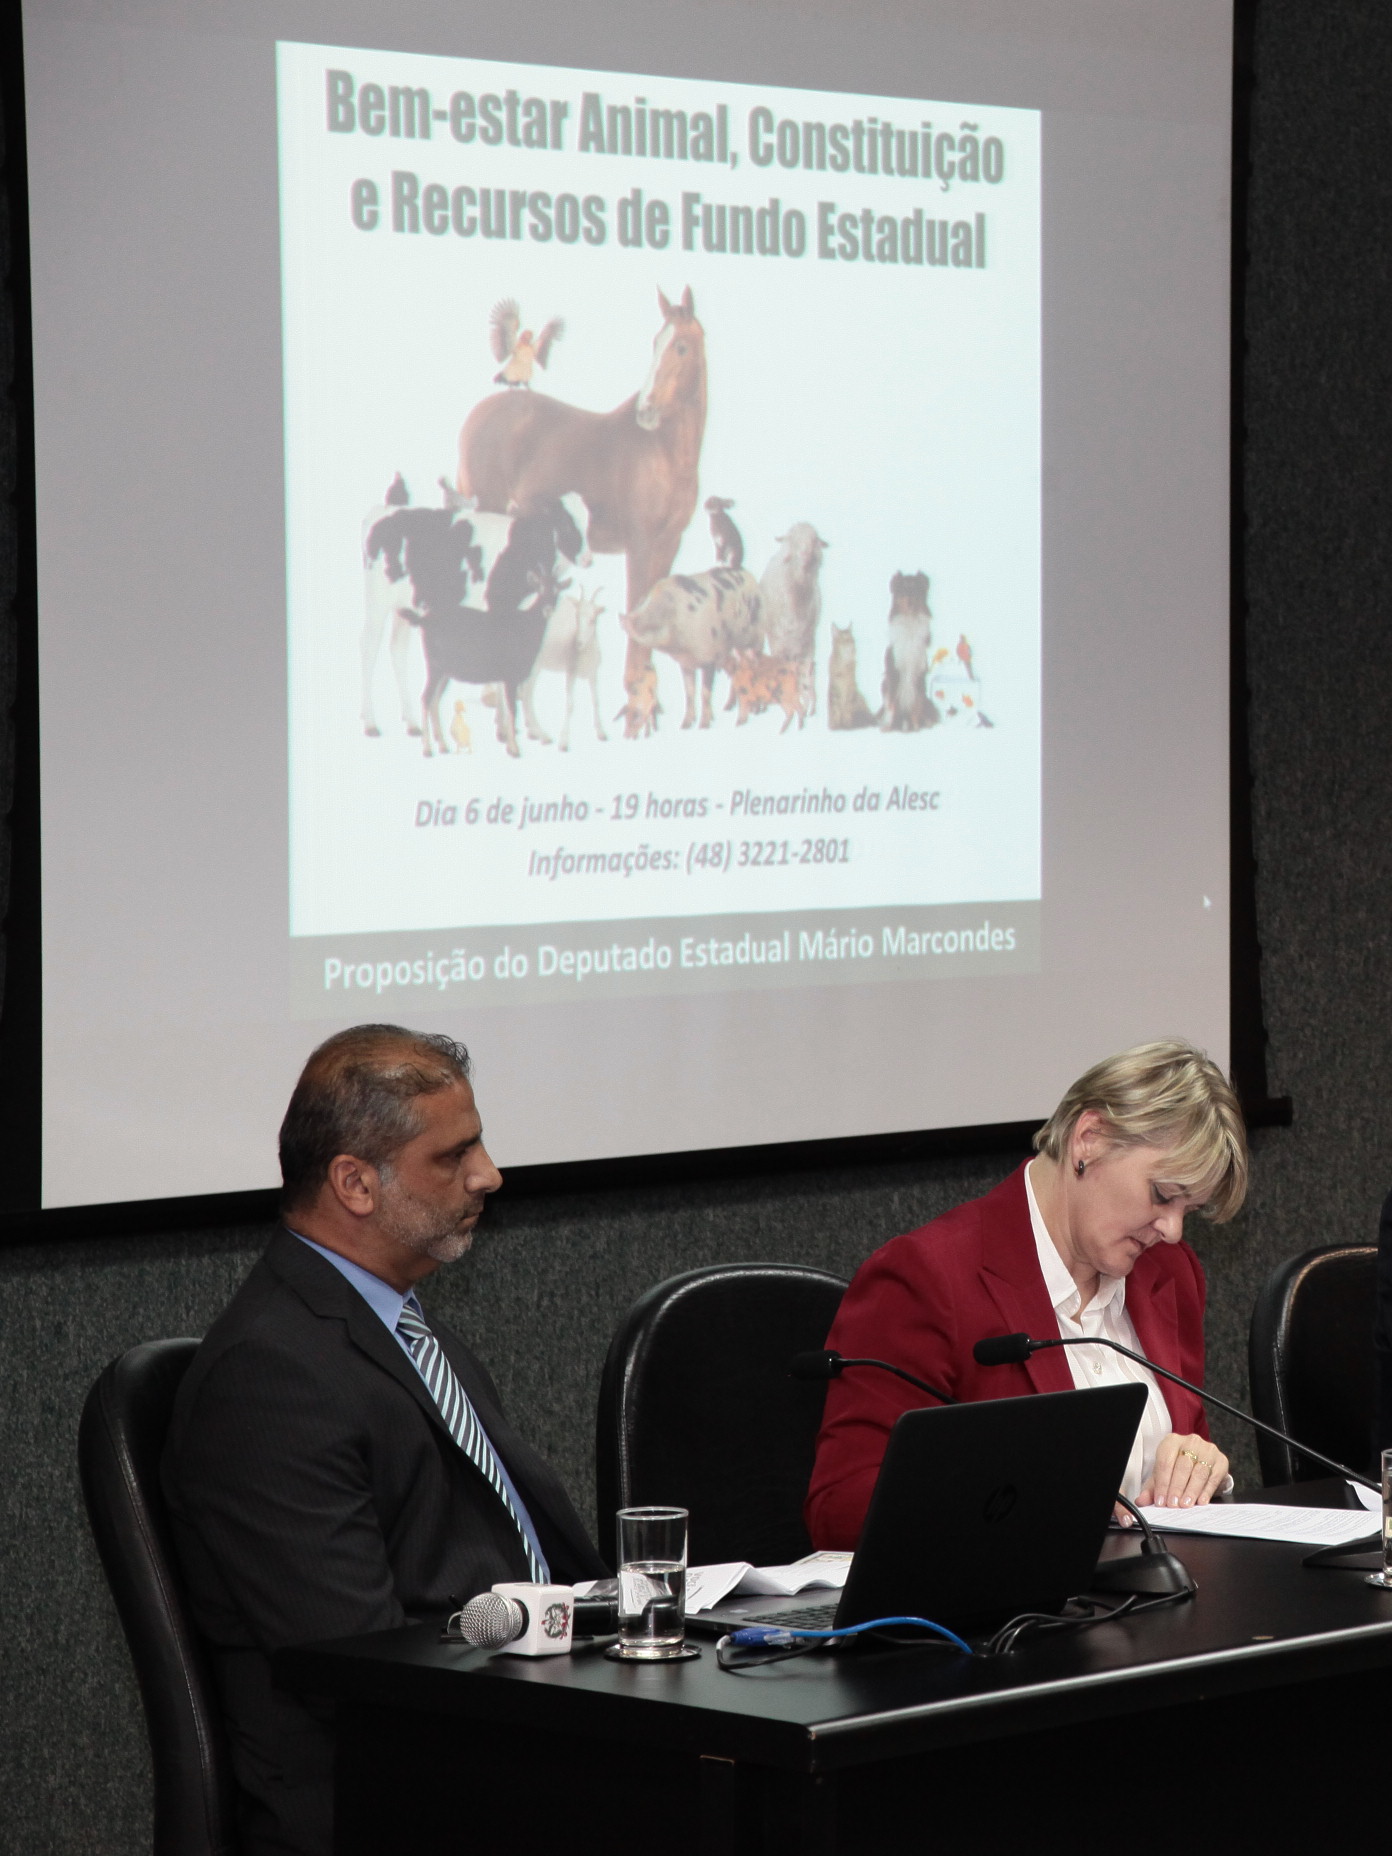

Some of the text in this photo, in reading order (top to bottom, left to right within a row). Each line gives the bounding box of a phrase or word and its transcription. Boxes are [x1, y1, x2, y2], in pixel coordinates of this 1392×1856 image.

[325, 68, 1004, 192] Bem-estar Animal, Constituição
[351, 170, 986, 269] e Recursos de Fundo Estadual
[415, 799, 457, 827] Dia
[464, 797, 480, 825] 6
[486, 796, 514, 824] de
[517, 794, 589, 831] junho
[610, 793, 640, 820] 19
[645, 791, 708, 819] horas
[730, 787, 846, 816] Plenarinho
[852, 786, 880, 812] da
[885, 784, 940, 811] Alesc
[528, 837, 850, 881] Informações: (48) 3221-2801
[324, 920, 1017, 994] Proposição do Deputado Estadual Mário Marcondes
